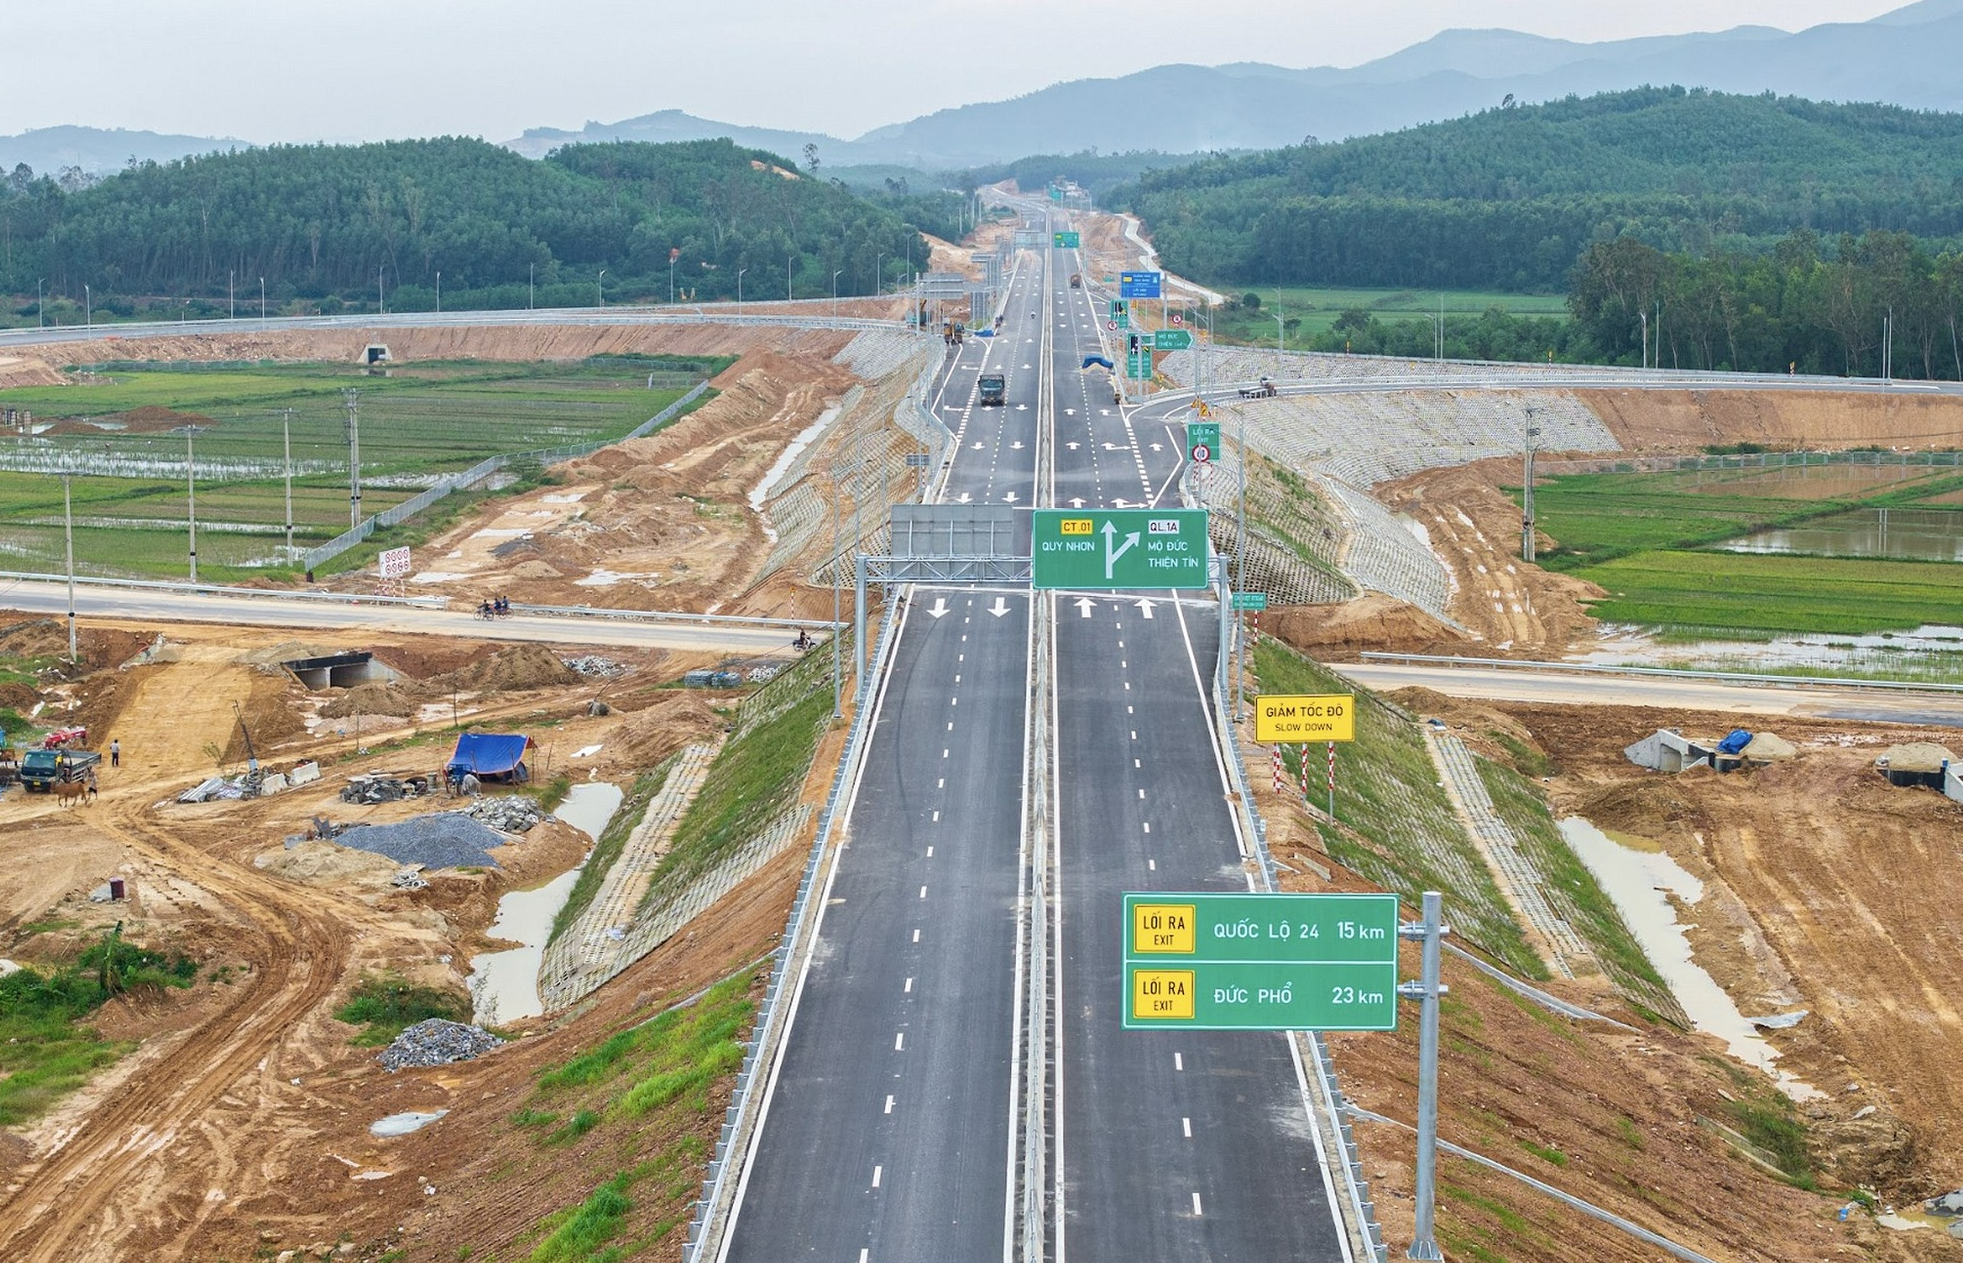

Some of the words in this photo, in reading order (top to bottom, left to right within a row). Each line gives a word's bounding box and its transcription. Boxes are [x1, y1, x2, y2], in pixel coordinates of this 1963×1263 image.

[1150, 522, 1178, 532] QL.1A
[1042, 541, 1063, 552] QUY
[1148, 539, 1164, 554] MỘ
[1166, 539, 1188, 551] ĐỨC
[1148, 555, 1179, 570] THIỆN
[1181, 554, 1199, 568] TÍN
[1266, 702, 1296, 718] GIẢM
[1300, 701, 1323, 717] TỐC
[1326, 703, 1344, 720] ĐỘ
[1275, 723, 1301, 732] SLOW
[1304, 723, 1333, 732] DOWN
[1143, 910, 1162, 930] LỐI
[1168, 915, 1185, 930] RA
[1214, 917, 1259, 938] QUỐC
[1268, 920, 1291, 942] LỘ
[1299, 923, 1319, 939] 24
[1337, 921, 1355, 939] 15
[1359, 924, 1385, 939] km
[1153, 934, 1175, 946] EXIT
[1143, 976, 1161, 995] LỐI
[1168, 981, 1185, 996] RA
[1213, 984, 1249, 1004] ĐỨC
[1258, 981, 1293, 1004] PHỔ
[1332, 986, 1354, 1004] 23
[1358, 989, 1384, 1004] km
[1153, 1000, 1173, 1012] EXIT
